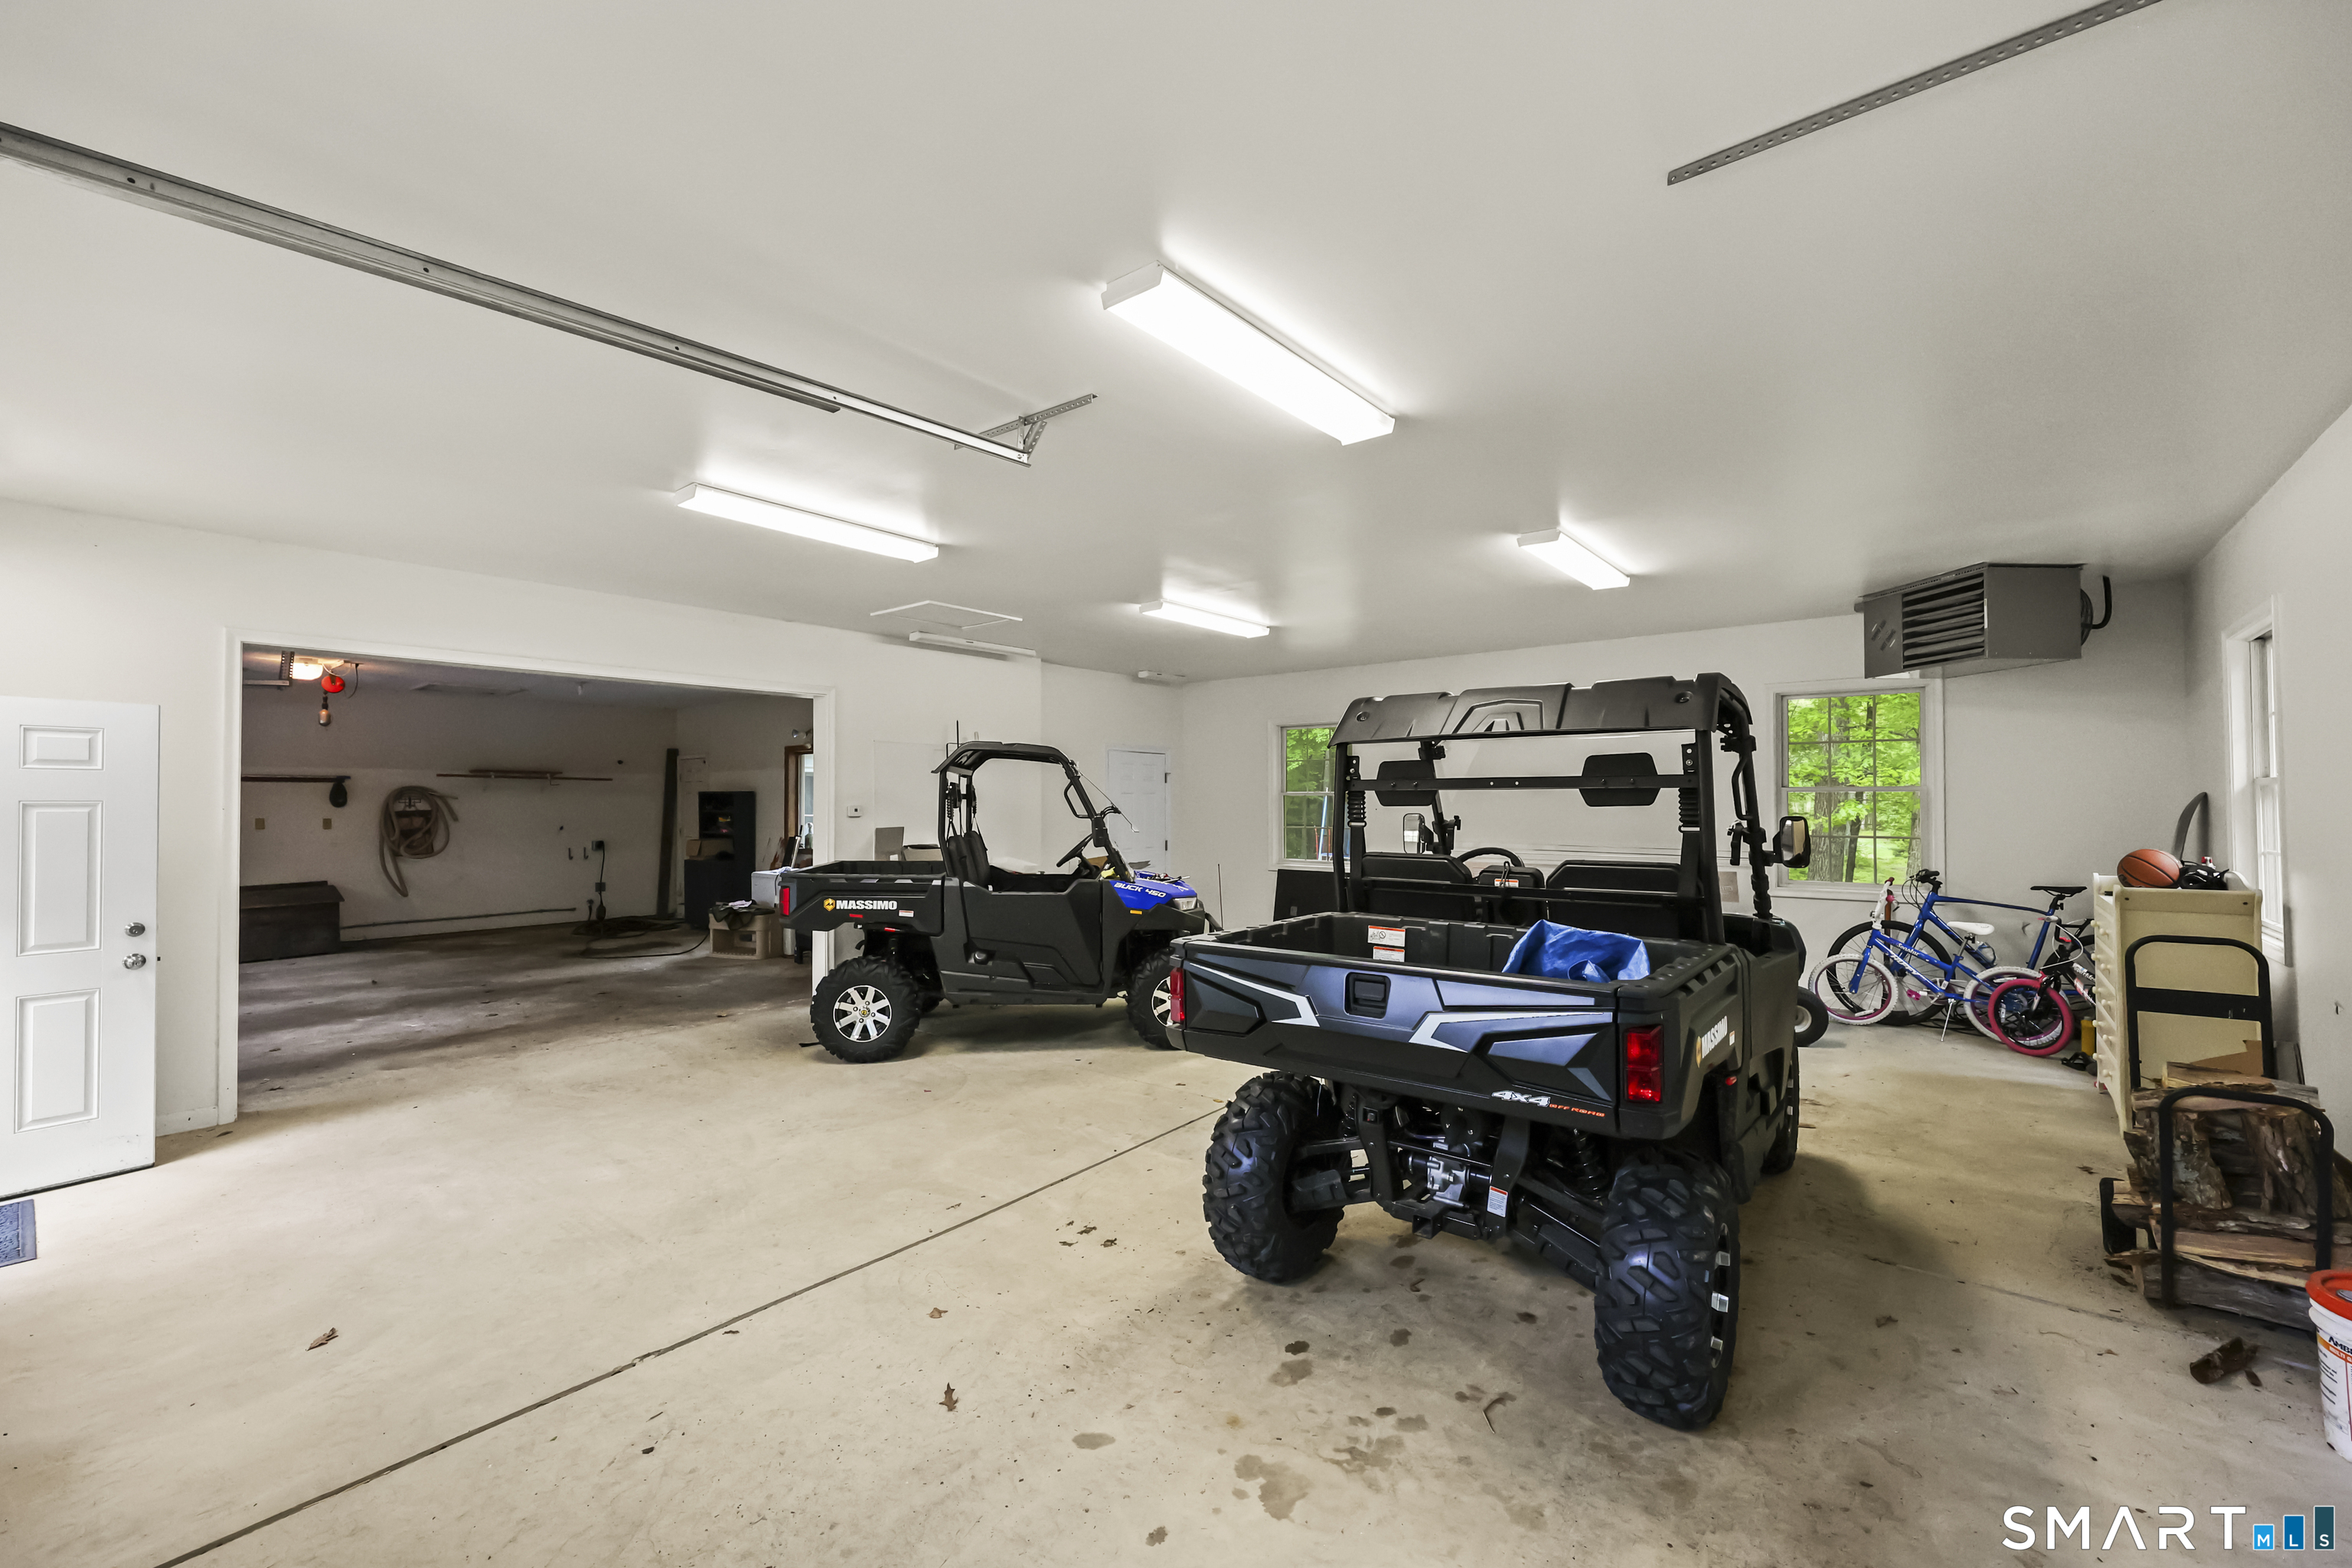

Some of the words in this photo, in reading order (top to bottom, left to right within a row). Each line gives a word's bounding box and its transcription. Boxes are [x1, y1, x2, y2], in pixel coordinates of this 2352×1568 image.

[1114, 882, 1144, 893] BUCK
[1145, 888, 1166, 898] 450
[836, 900, 897, 910] MASSIMO
[1701, 1015, 1728, 1059] MASSIMO
[1570, 1107, 1606, 1118] ROAD
[2328, 1336, 2352, 1355] AMB
